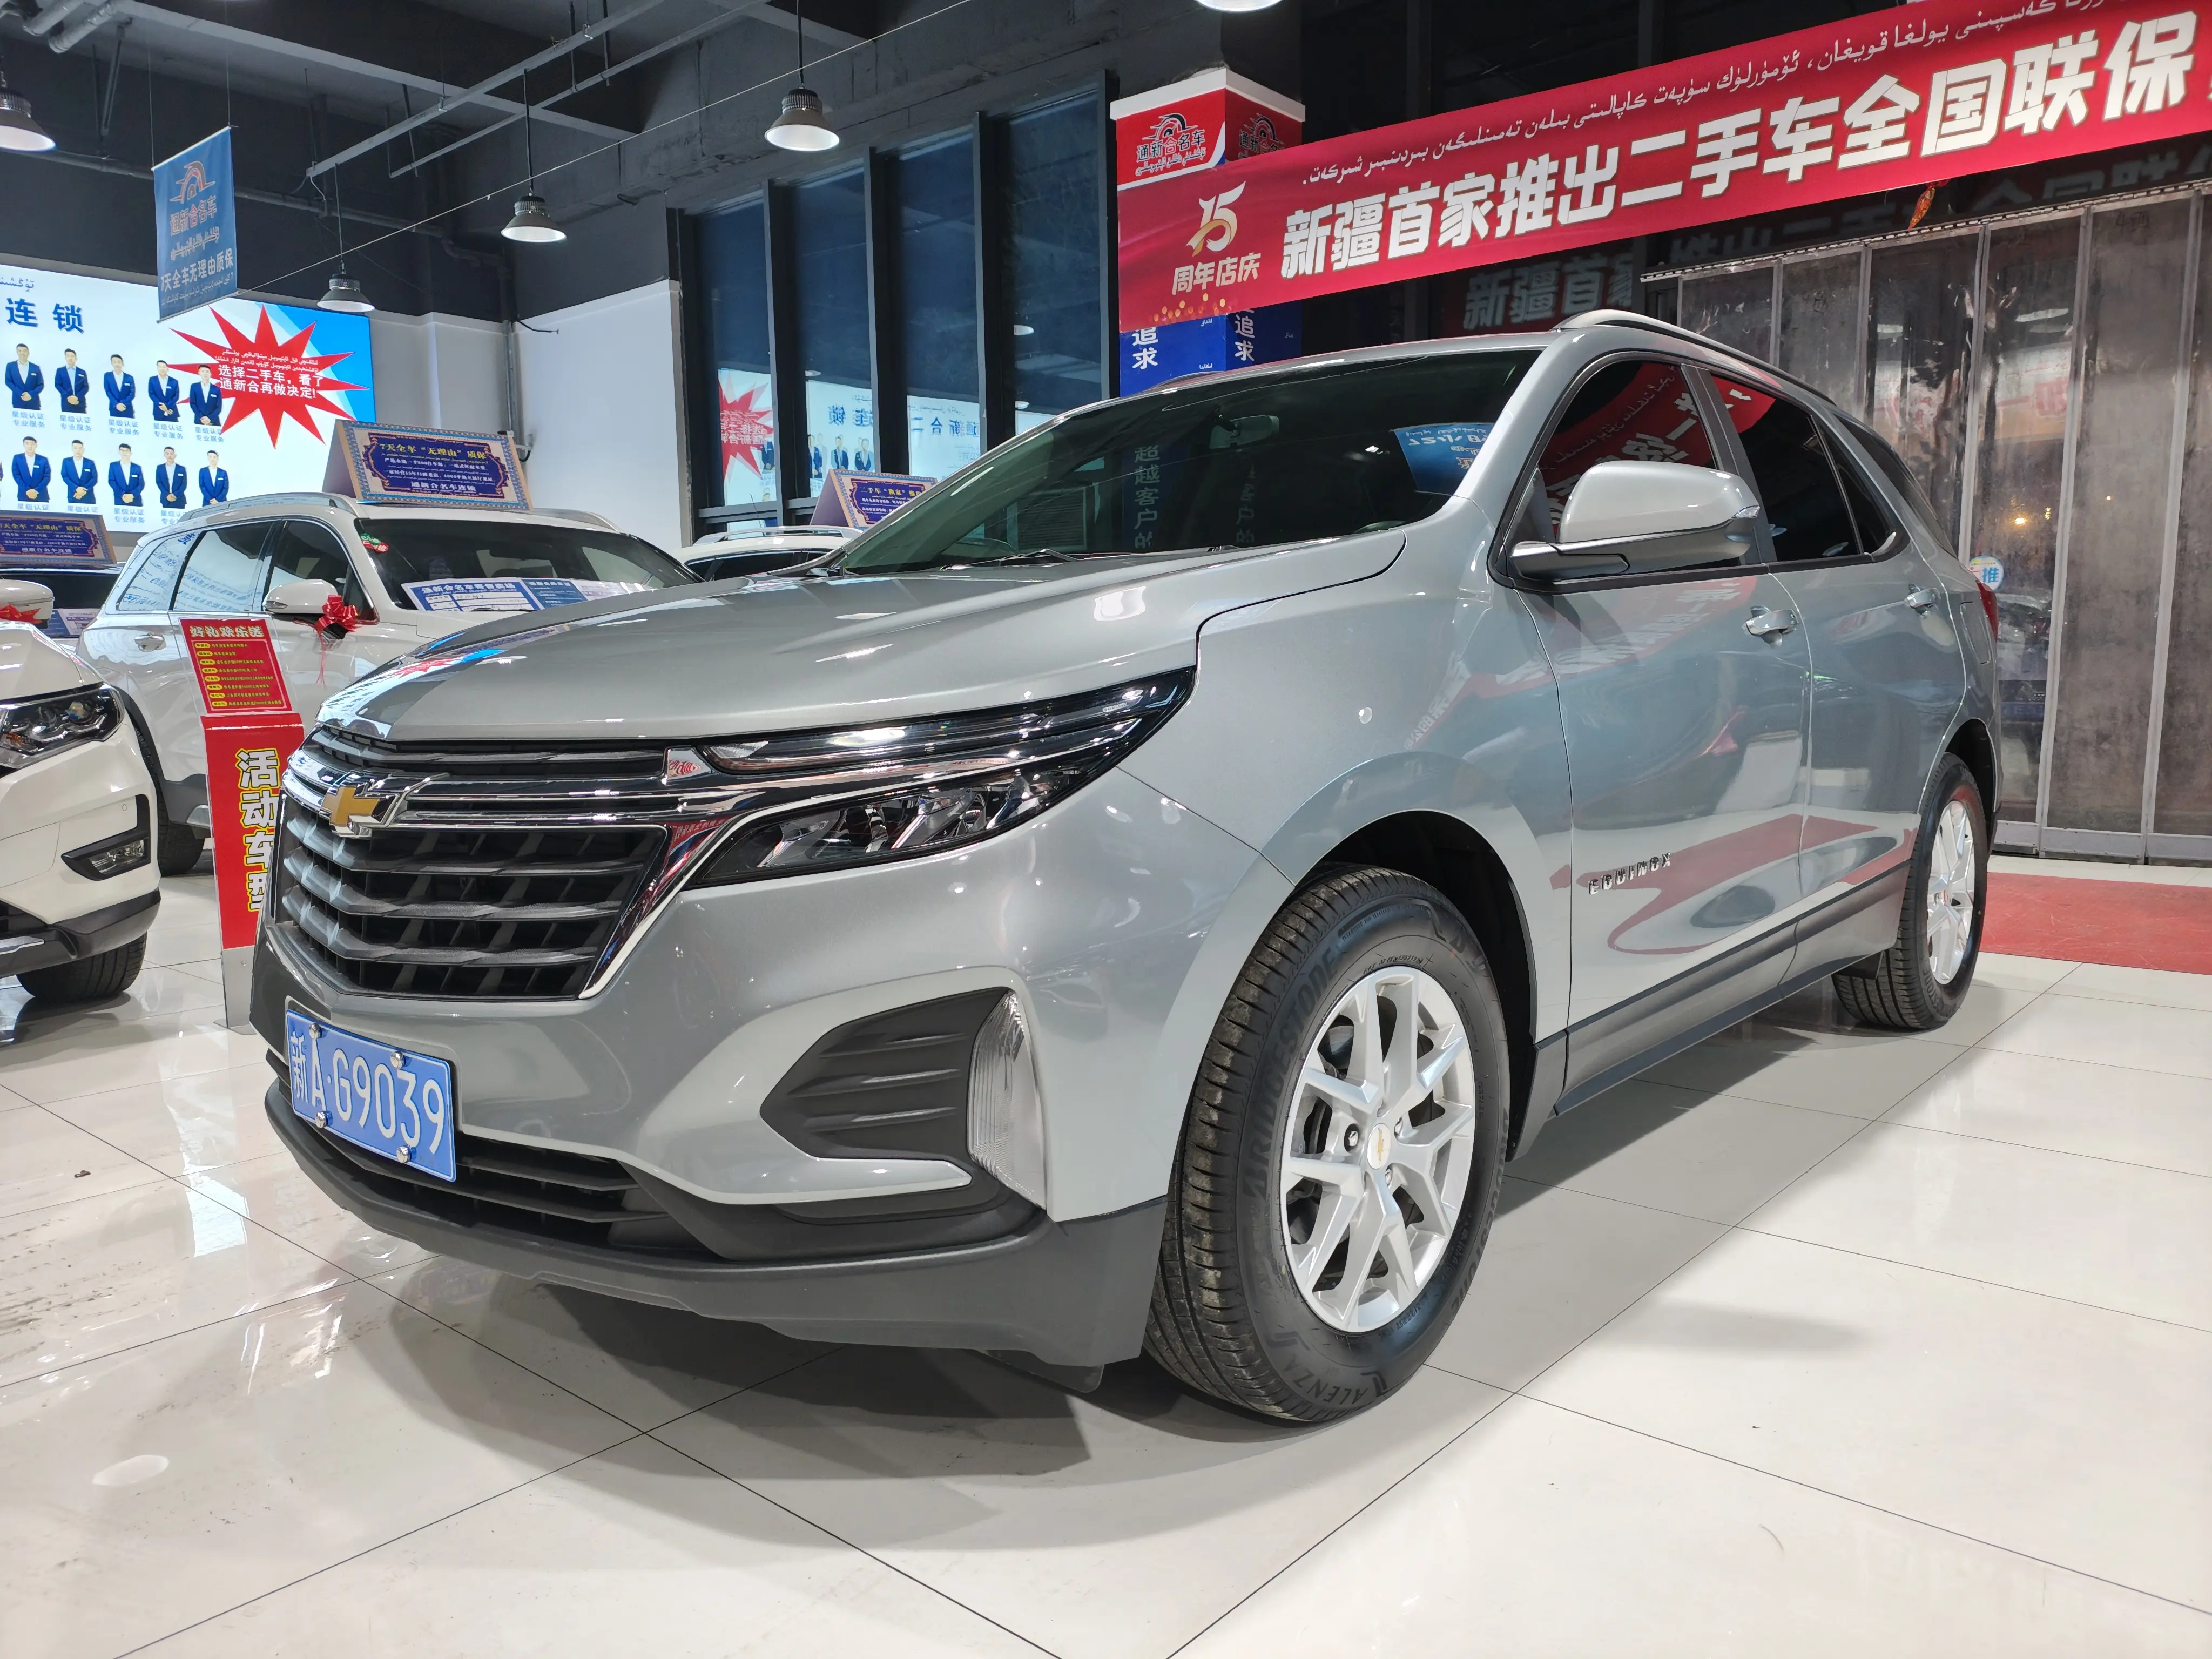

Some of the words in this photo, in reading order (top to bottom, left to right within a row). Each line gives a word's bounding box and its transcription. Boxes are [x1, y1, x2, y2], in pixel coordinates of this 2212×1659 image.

[1137, 129, 1206, 162] 通新合名车
[1280, 11, 2212, 280] 新疆首家推出二手车全国联保
[1172, 252, 1262, 295] 周年店庆
[1588, 852, 1671, 895] EQUINOX
